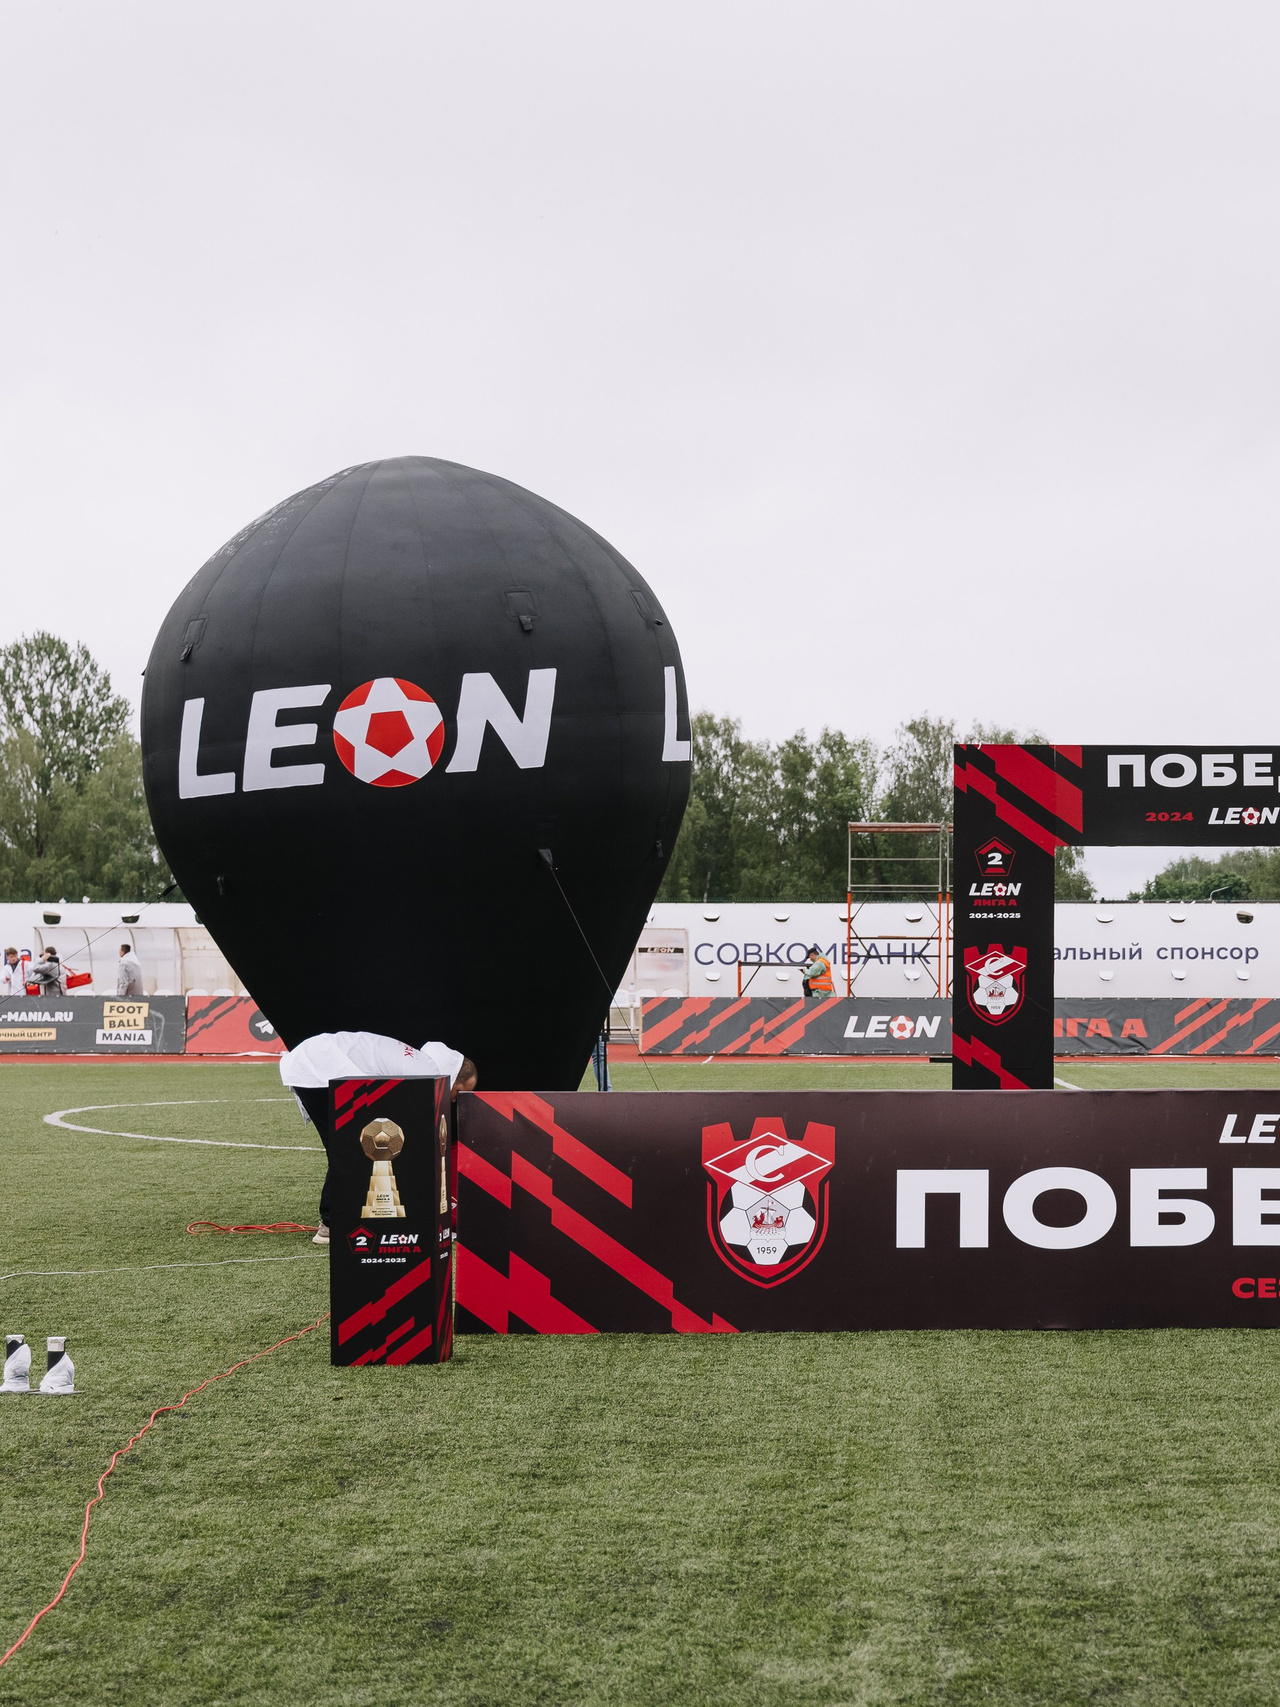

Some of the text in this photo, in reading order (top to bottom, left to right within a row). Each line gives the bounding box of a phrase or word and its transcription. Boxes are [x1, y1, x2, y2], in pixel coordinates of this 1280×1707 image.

[178, 667, 558, 800] LEON
[1145, 811, 1194, 822] 2024
[1207, 806, 1280, 826] LEON
[987, 852, 1003, 866] 2
[968, 882, 1022, 897] LEON
[973, 899, 1018, 907] ЛИГА А
[1054, 942, 1259, 965] альный спонсор
[109, 1005, 144, 1014] FOOT
[0, 1010, 74, 1023] -MANIA.RU
[109, 1018, 140, 1029] BALL
[843, 1015, 942, 1040] LEON
[1120, 1017, 1148, 1038] А
[26, 1031, 53, 1039] ЦЕНТР
[101, 1032, 146, 1042] MANIA
[355, 1236, 368, 1246] 2
[380, 1233, 419, 1245] LEON
[378, 1245, 422, 1254] ЛИГА А
[756, 1246, 778, 1255] 1959
